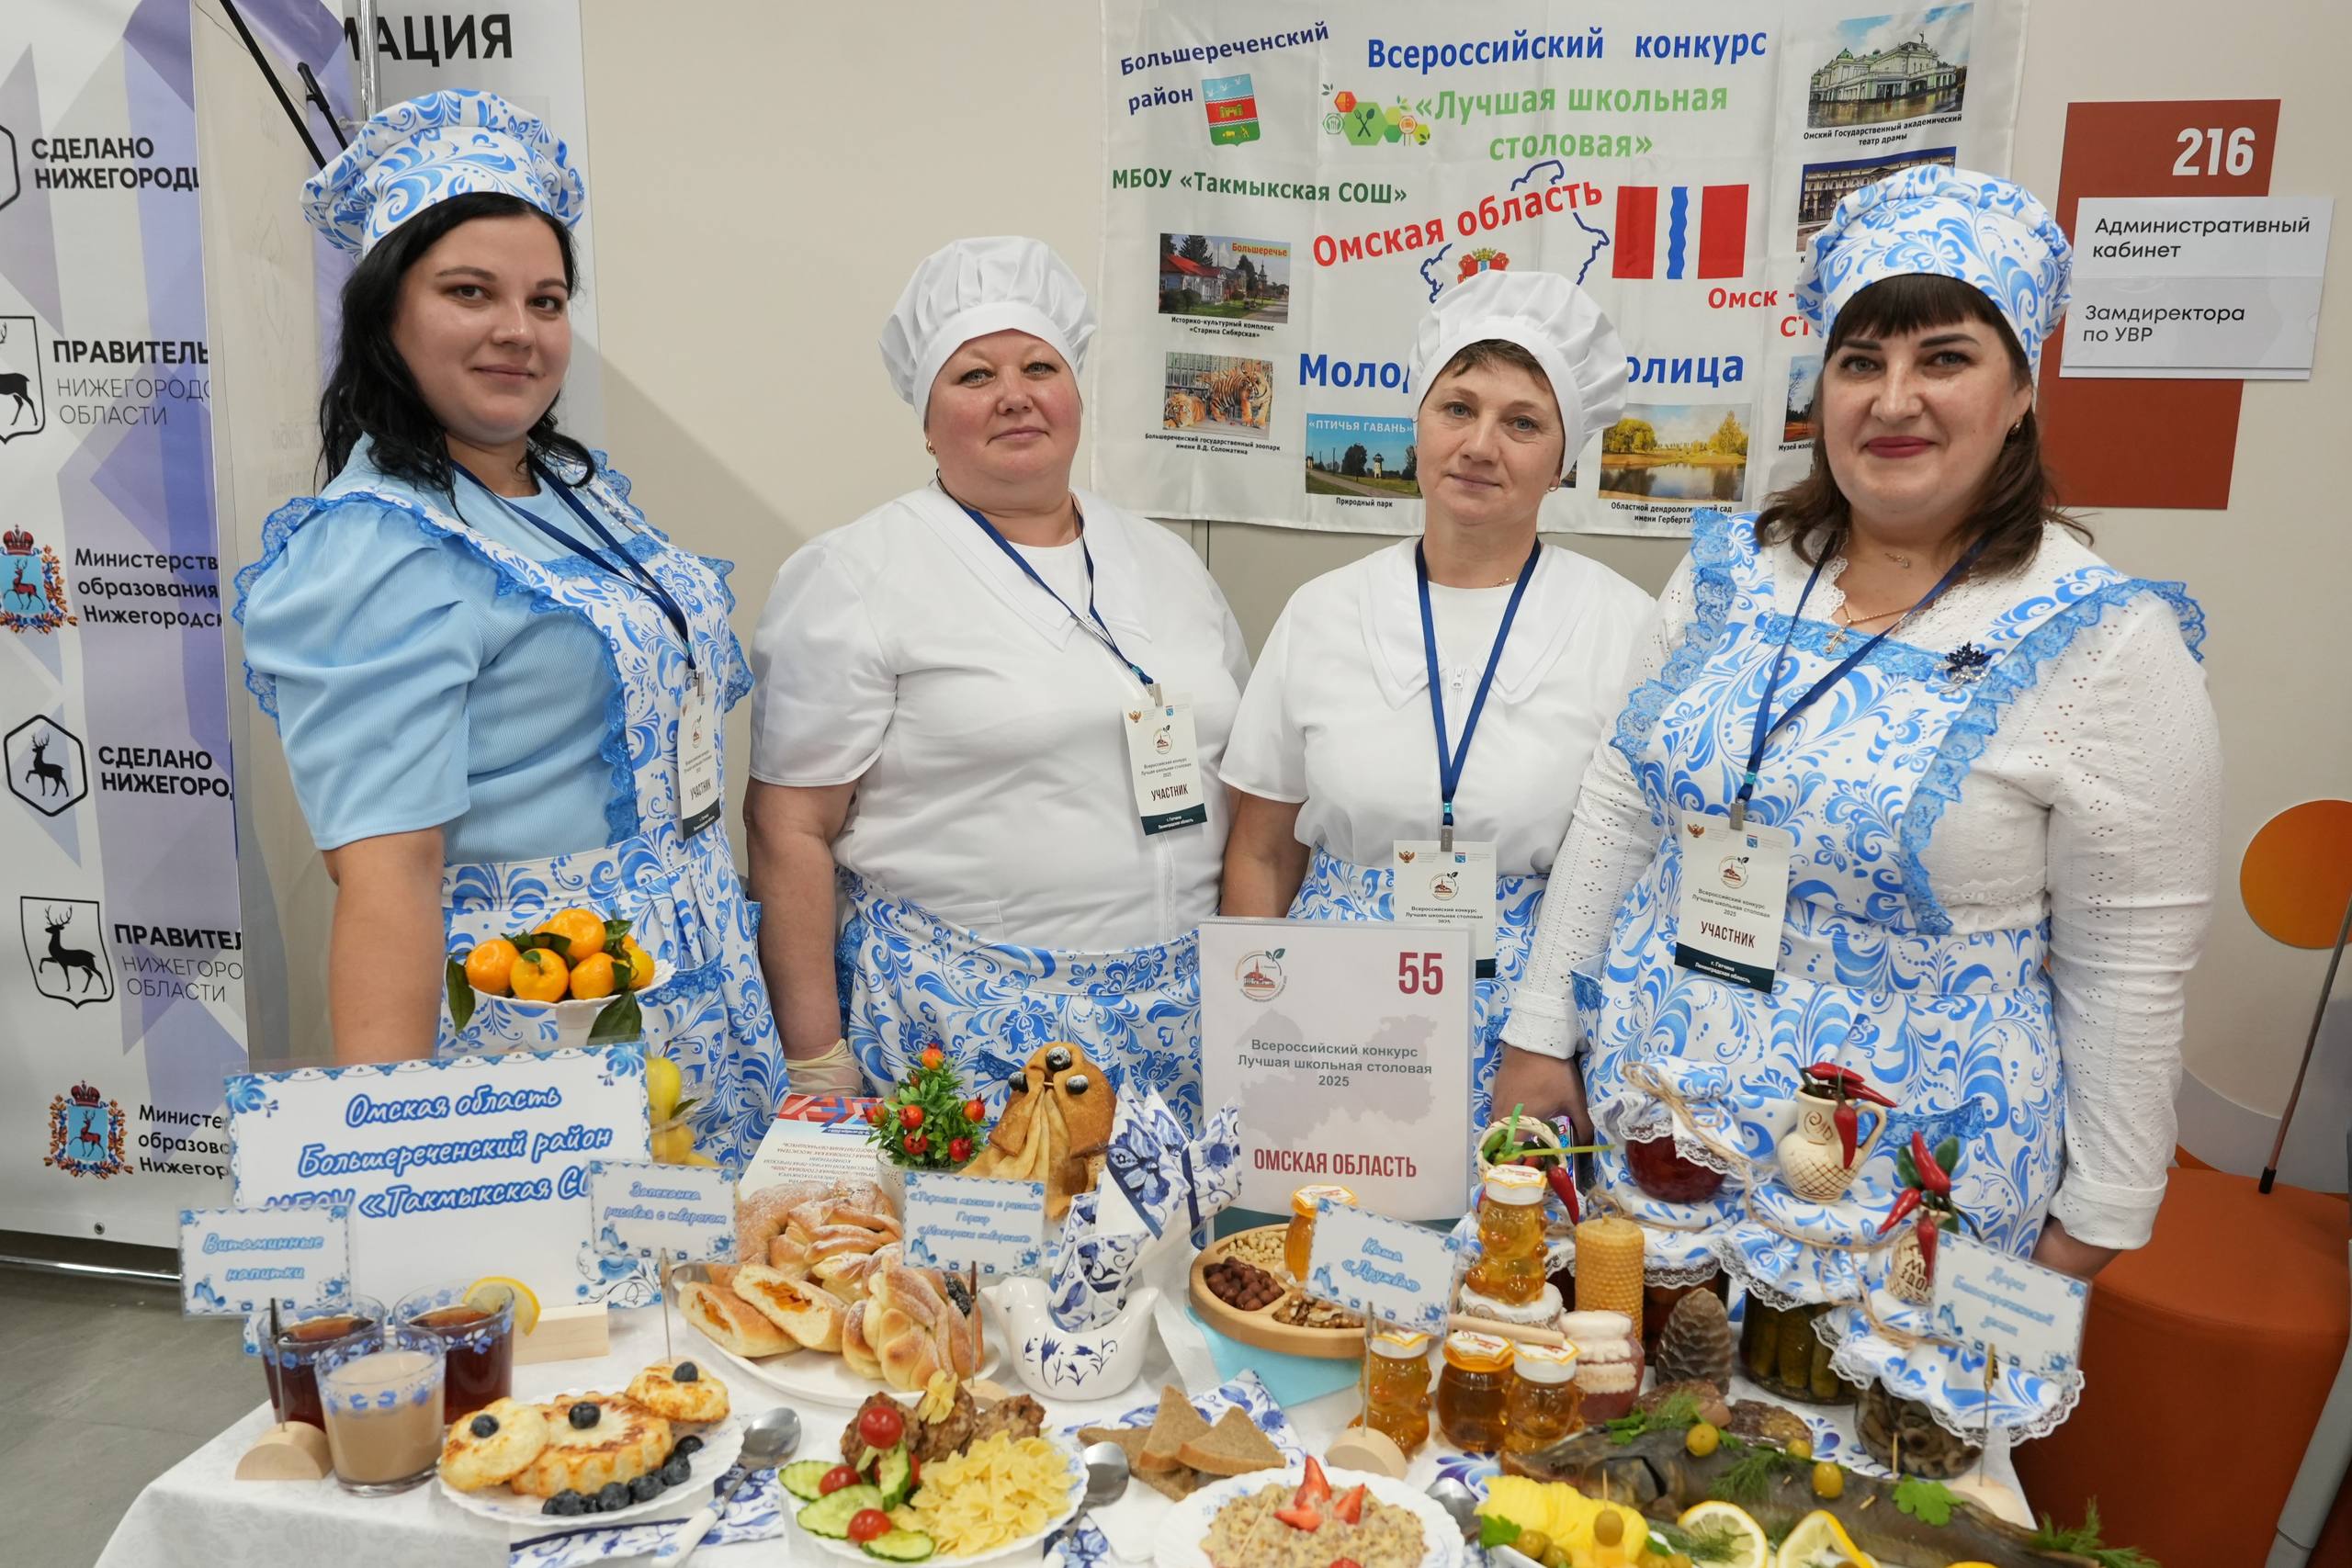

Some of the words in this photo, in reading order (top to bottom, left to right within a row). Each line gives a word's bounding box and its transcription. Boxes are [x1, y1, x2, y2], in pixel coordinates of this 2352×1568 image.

[1121, 21, 1329, 75] Большереченский
[1368, 27, 1604, 75] Всероссийский
[1635, 32, 1767, 65] конкурс
[1128, 86, 1194, 115] район
[1416, 88, 1555, 125] «Лучшая
[1568, 87, 1728, 112] школьная
[1804, 131, 1833, 141] Омский
[1835, 123, 1902, 138] Государственный
[1904, 115, 1962, 130] академический
[32, 137, 154, 161] СДЕЛАНО
[1489, 133, 1653, 161] столовая»
[1859, 137, 1880, 146] театр
[1882, 133, 1907, 144] драмы
[2172, 127, 2256, 176] 216
[1112, 168, 1172, 189] МБОУ
[1180, 173, 1330, 202] «Такмыкская
[1338, 183, 1408, 205] СОШ»
[1313, 219, 1444, 267] Омская
[1457, 181, 1603, 237] область
[2095, 216, 2311, 237] Административный
[1232, 243, 1287, 256] Большеречье
[2092, 242, 2181, 258] кабинет
[1708, 288, 1778, 309] Омск
[1171, 316, 1242, 327] Историко-культурный
[1244, 321, 1274, 332] комплекс
[2086, 305, 2245, 324] Замдиректора
[1190, 327, 1220, 335] «Старина
[1222, 328, 1260, 338] Сибирская»
[2083, 328, 2109, 342] по
[2114, 327, 2154, 342] УВР
[60, 405, 167, 425] ОБЛАСТИ
[1308, 420, 1360, 432] «ПТИЧЬЯ
[1363, 422, 1414, 434] ГАВАНЬ»
[1145, 433, 1199, 444] Большереченский
[1200, 437, 1254, 448] государственный
[1210, 446, 1248, 455] Соломатина
[1336, 497, 1375, 508] Природный
[1377, 500, 1393, 509] парк
[1611, 502, 1648, 512] Областной
[1658, 515, 1690, 525] Герберта
[74, 548, 219, 574] Министерств
[77, 577, 219, 599] образования
[98, 746, 212, 770] СДЕЛАНО
[101, 773, 232, 801] НИЖЕГОРО
[1151, 784, 1189, 801] УЧАСТНИК
[1698, 888, 1742, 903] Всероссийский
[1742, 900, 1765, 909] конкурс
[1714, 900, 1743, 911] школьная
[1743, 908, 1770, 918] столовая
[1723, 908, 1736, 918] 2025
[1701, 920, 1756, 949] УЧАСТНИК
[121, 955, 243, 980] НИЖЕГОРО
[1398, 952, 1444, 995] 55
[127, 978, 226, 1002] ОБЛАСТИ
[1251, 1039, 1359, 1055] Всероссийский
[1363, 1044, 1419, 1058] конкурс
[1238, 1055, 1290, 1068] Лучшая
[1295, 1058, 1363, 1072] школьная
[1367, 1062, 1432, 1075] столовая
[1318, 1076, 1350, 1087] 2025
[345, 1093, 448, 1127] Омская
[455, 1084, 561, 1116] область
[298, 1129, 526, 1178] Большереченский
[533, 1127, 612, 1156] район
[1253, 1148, 1328, 1174] ОМСКАЯ
[1332, 1153, 1417, 1178] ОБЛАСТЬ
[358, 1179, 551, 1218] «Такмыкская
[629, 1180, 702, 1201] Запеканка
[604, 1204, 654, 1220] рисовая
[657, 1211, 666, 1220] с
[667, 1208, 727, 1226] творогом
[202, 1233, 324, 1255] Витаминные
[1362, 1237, 1404, 1263] Каша
[226, 1267, 305, 1281] напитки
[1341, 1259, 1421, 1293] «Дружба»
